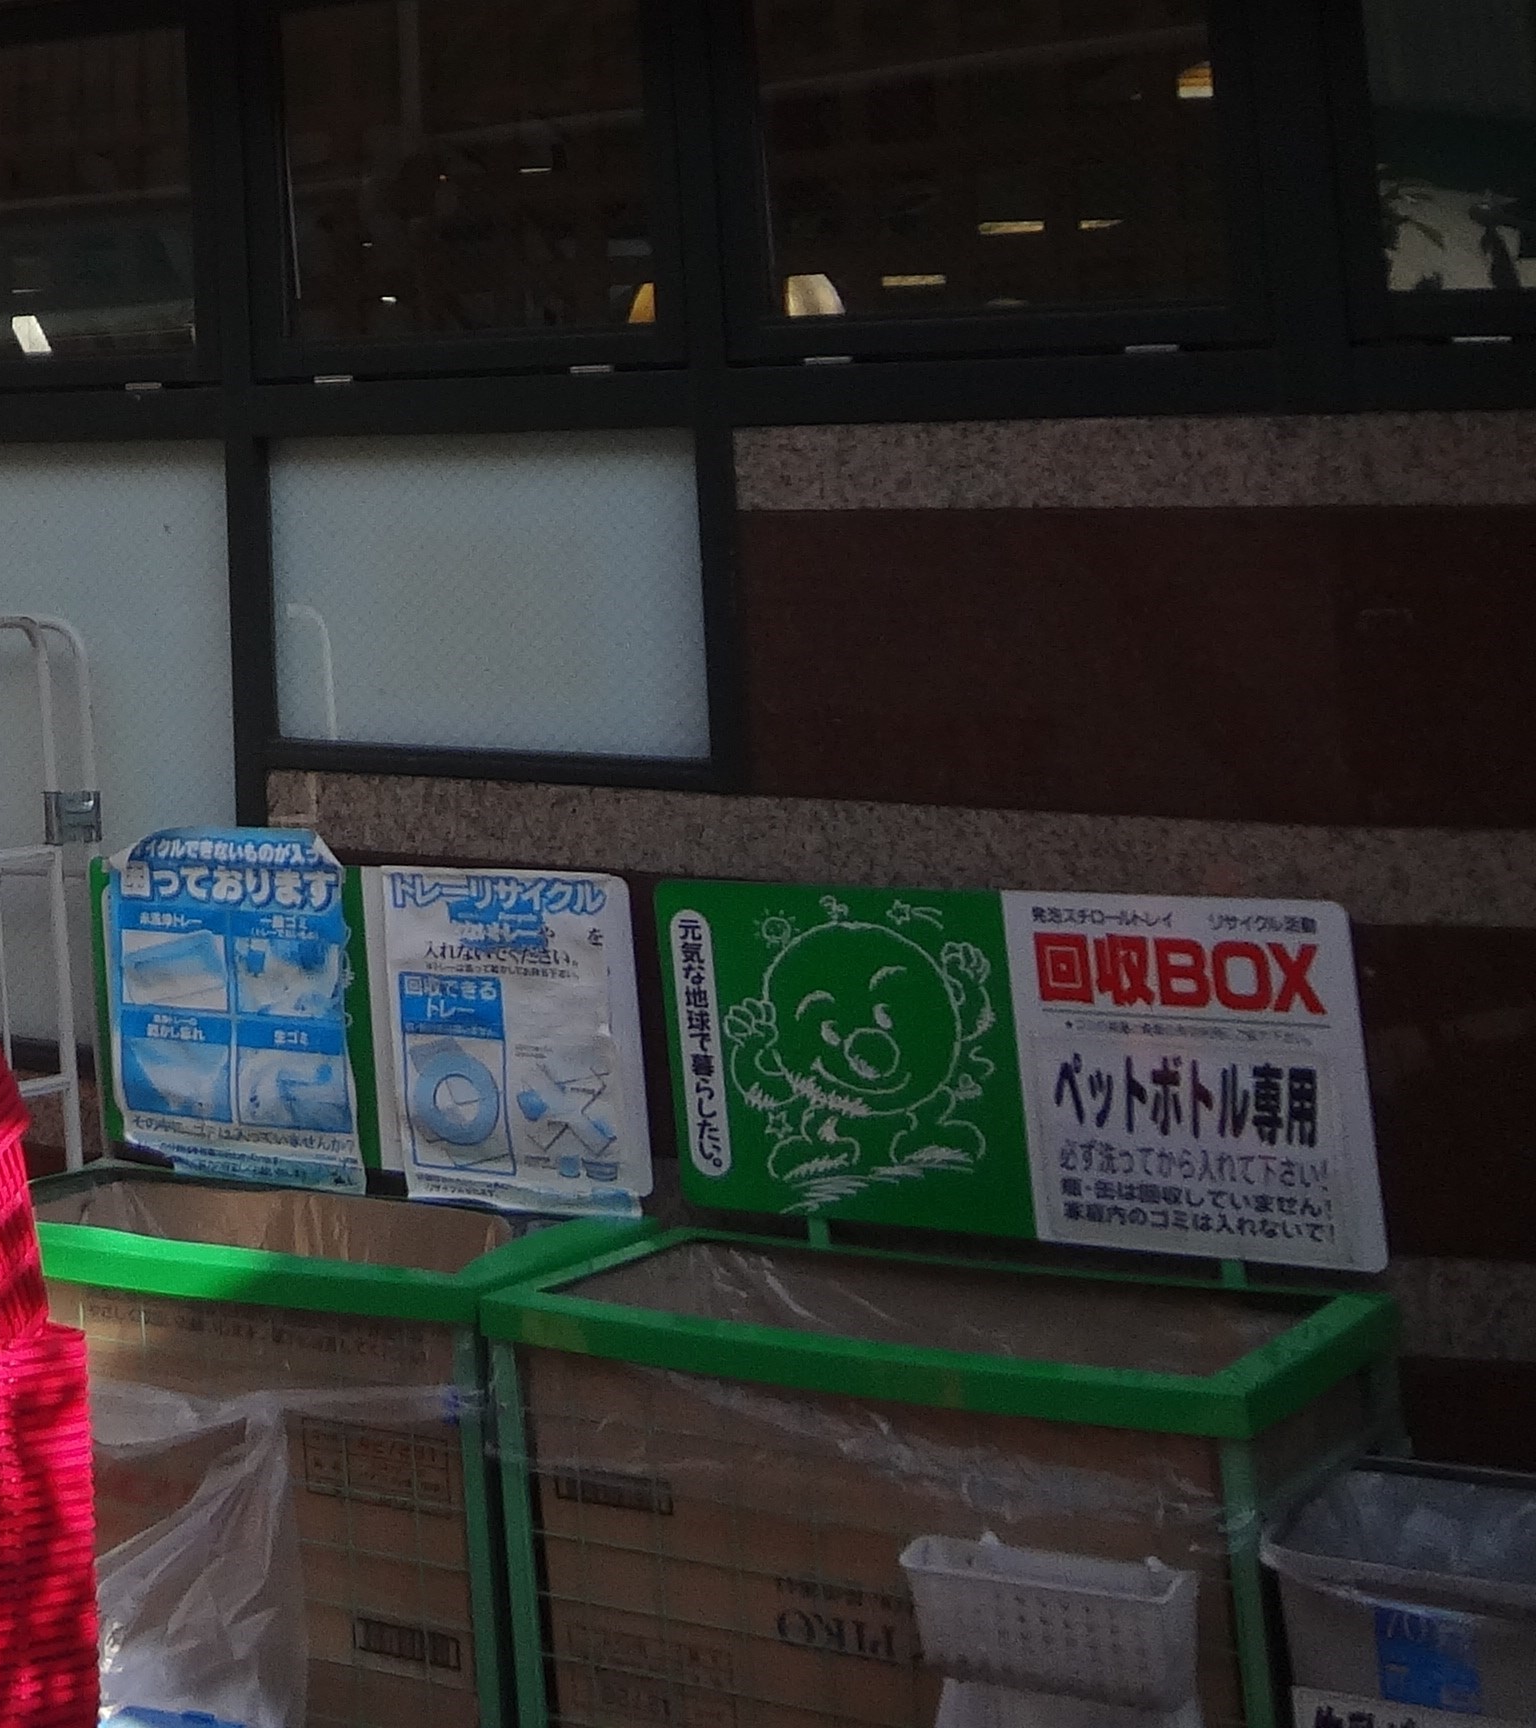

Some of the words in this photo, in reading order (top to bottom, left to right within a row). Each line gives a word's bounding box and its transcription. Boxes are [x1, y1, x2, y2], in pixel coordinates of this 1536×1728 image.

[120, 860, 338, 910] 困っております
[391, 873, 608, 915] トレーリサイクル
[1031, 905, 1174, 929] 発泡スチロールトレイ
[1207, 912, 1318, 934] リサイクル活動
[404, 975, 498, 1001] 回収できる
[1033, 931, 1328, 1016] 回収BOX
[427, 998, 476, 1018] トレー
[273, 1030, 310, 1045] 生ゴミ
[678, 918, 723, 1168] 元気な地球で暮らしたい。
[1054, 1052, 1319, 1149] ペットボトル専用
